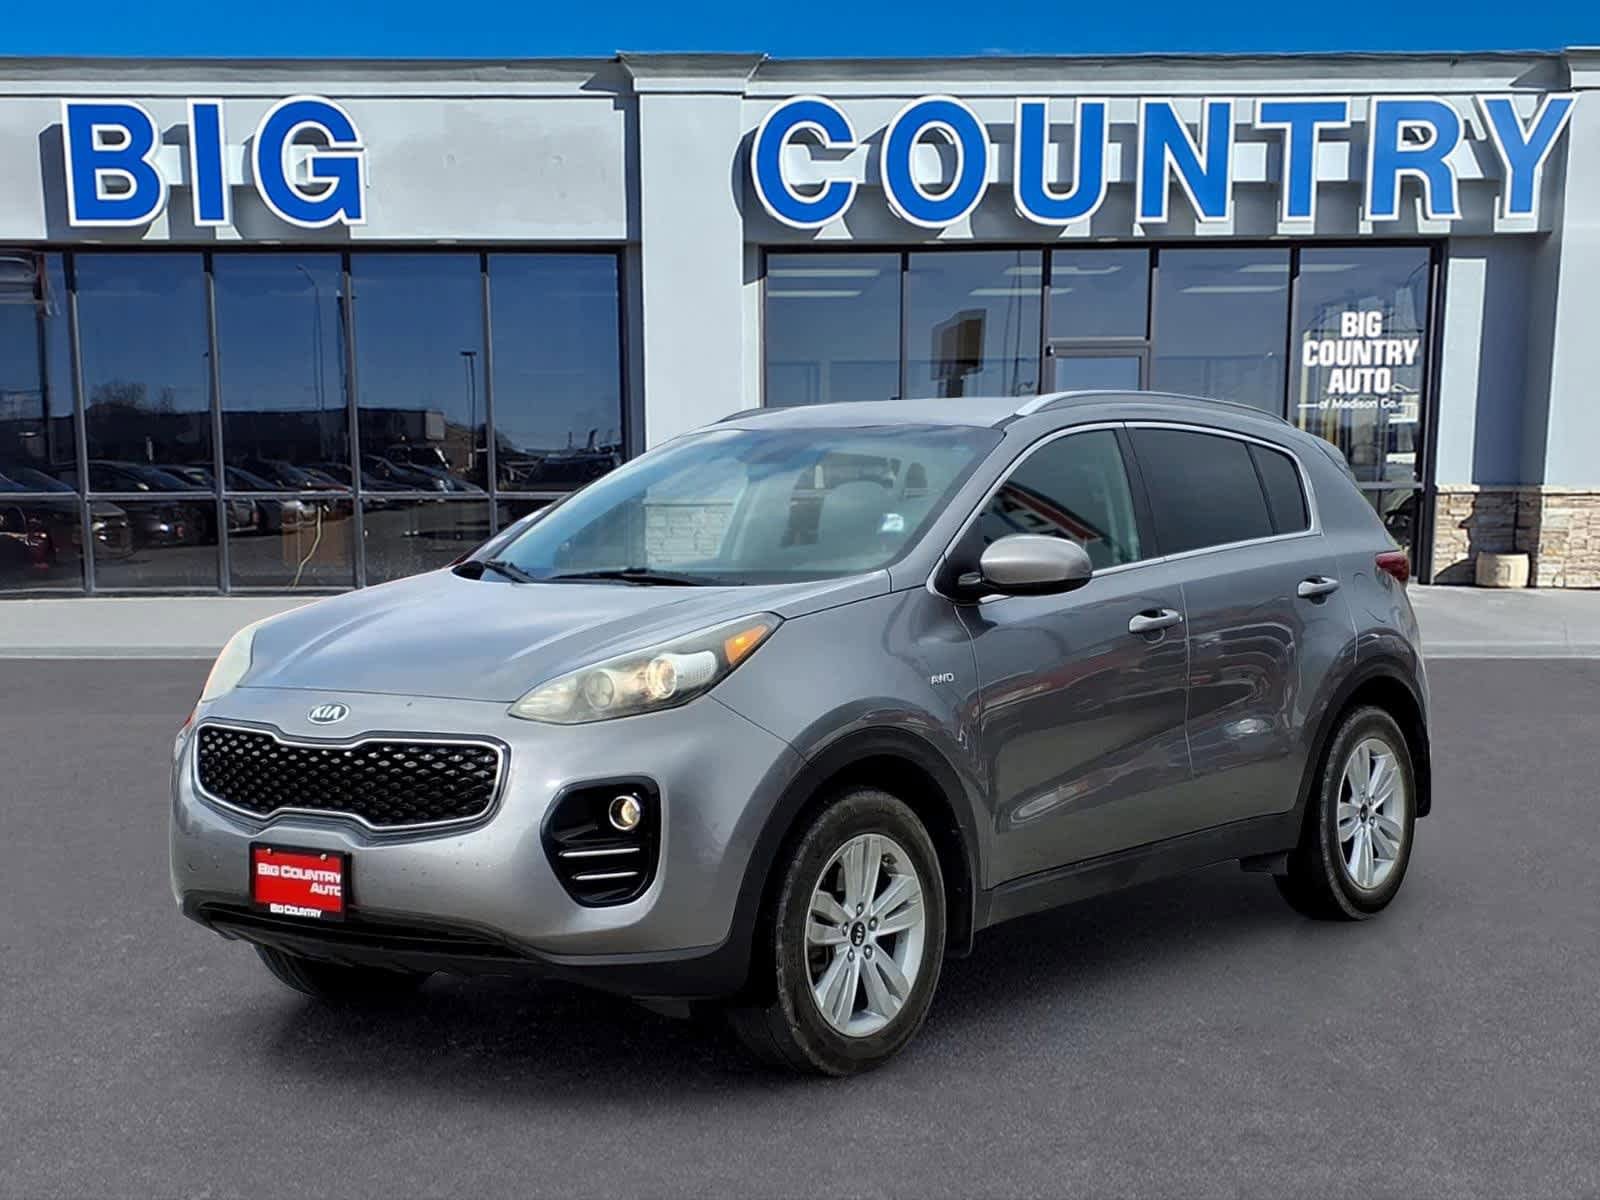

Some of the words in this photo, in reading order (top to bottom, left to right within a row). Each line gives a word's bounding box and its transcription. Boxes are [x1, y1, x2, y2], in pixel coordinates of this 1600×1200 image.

[61, 95, 367, 228] BIG
[750, 93, 1578, 230] COUNTRY
[1341, 311, 1383, 338] BIG
[1303, 339, 1419, 367] COUNTRY
[1328, 367, 1391, 394] AUTO
[1318, 398, 1329, 409] of
[310, 705, 341, 720] KIA
[280, 865, 341, 883] COUNTRY
